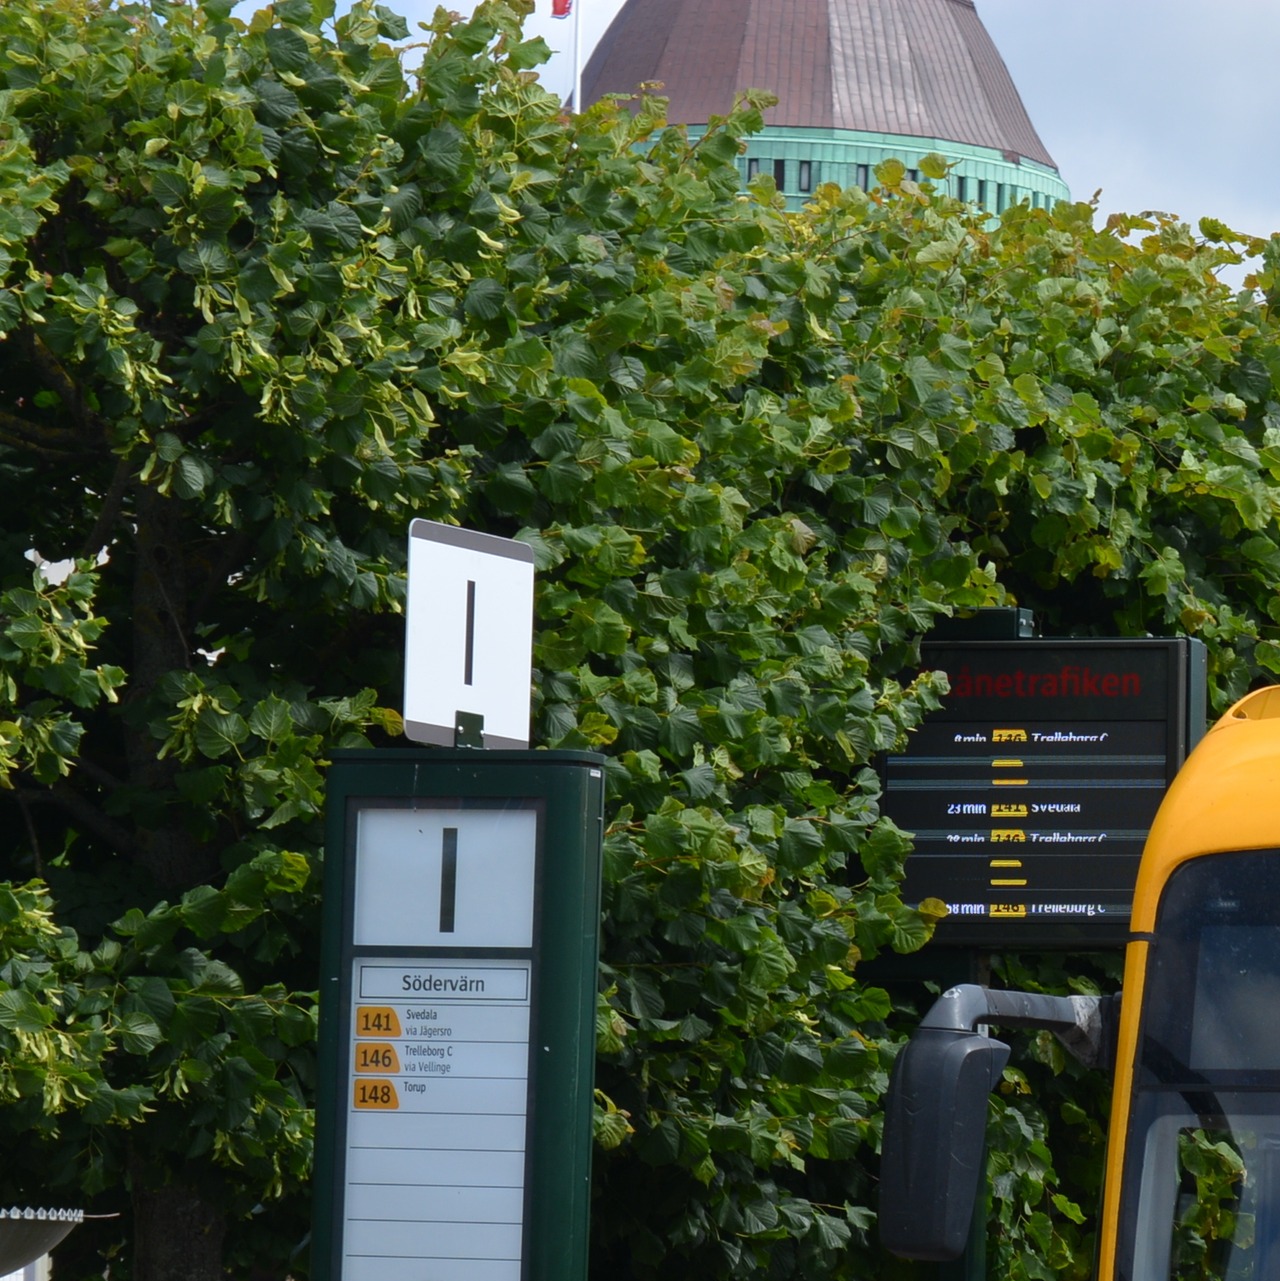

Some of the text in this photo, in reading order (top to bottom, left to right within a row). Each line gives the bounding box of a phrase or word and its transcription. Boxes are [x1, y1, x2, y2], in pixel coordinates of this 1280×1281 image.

[945, 665, 1141, 698] ånetrafiken
[402, 974, 485, 993] Södervärn
[362, 1012, 392, 1032] 141
[406, 1009, 438, 1021] Svedala
[405, 1025, 452, 1038] via Jägersro
[360, 1049, 392, 1068] 146
[405, 1045, 453, 1059] Trelleborg C
[404, 1061, 451, 1075] via Vellinge
[359, 1085, 391, 1104] 148
[404, 1081, 427, 1095] Torup
